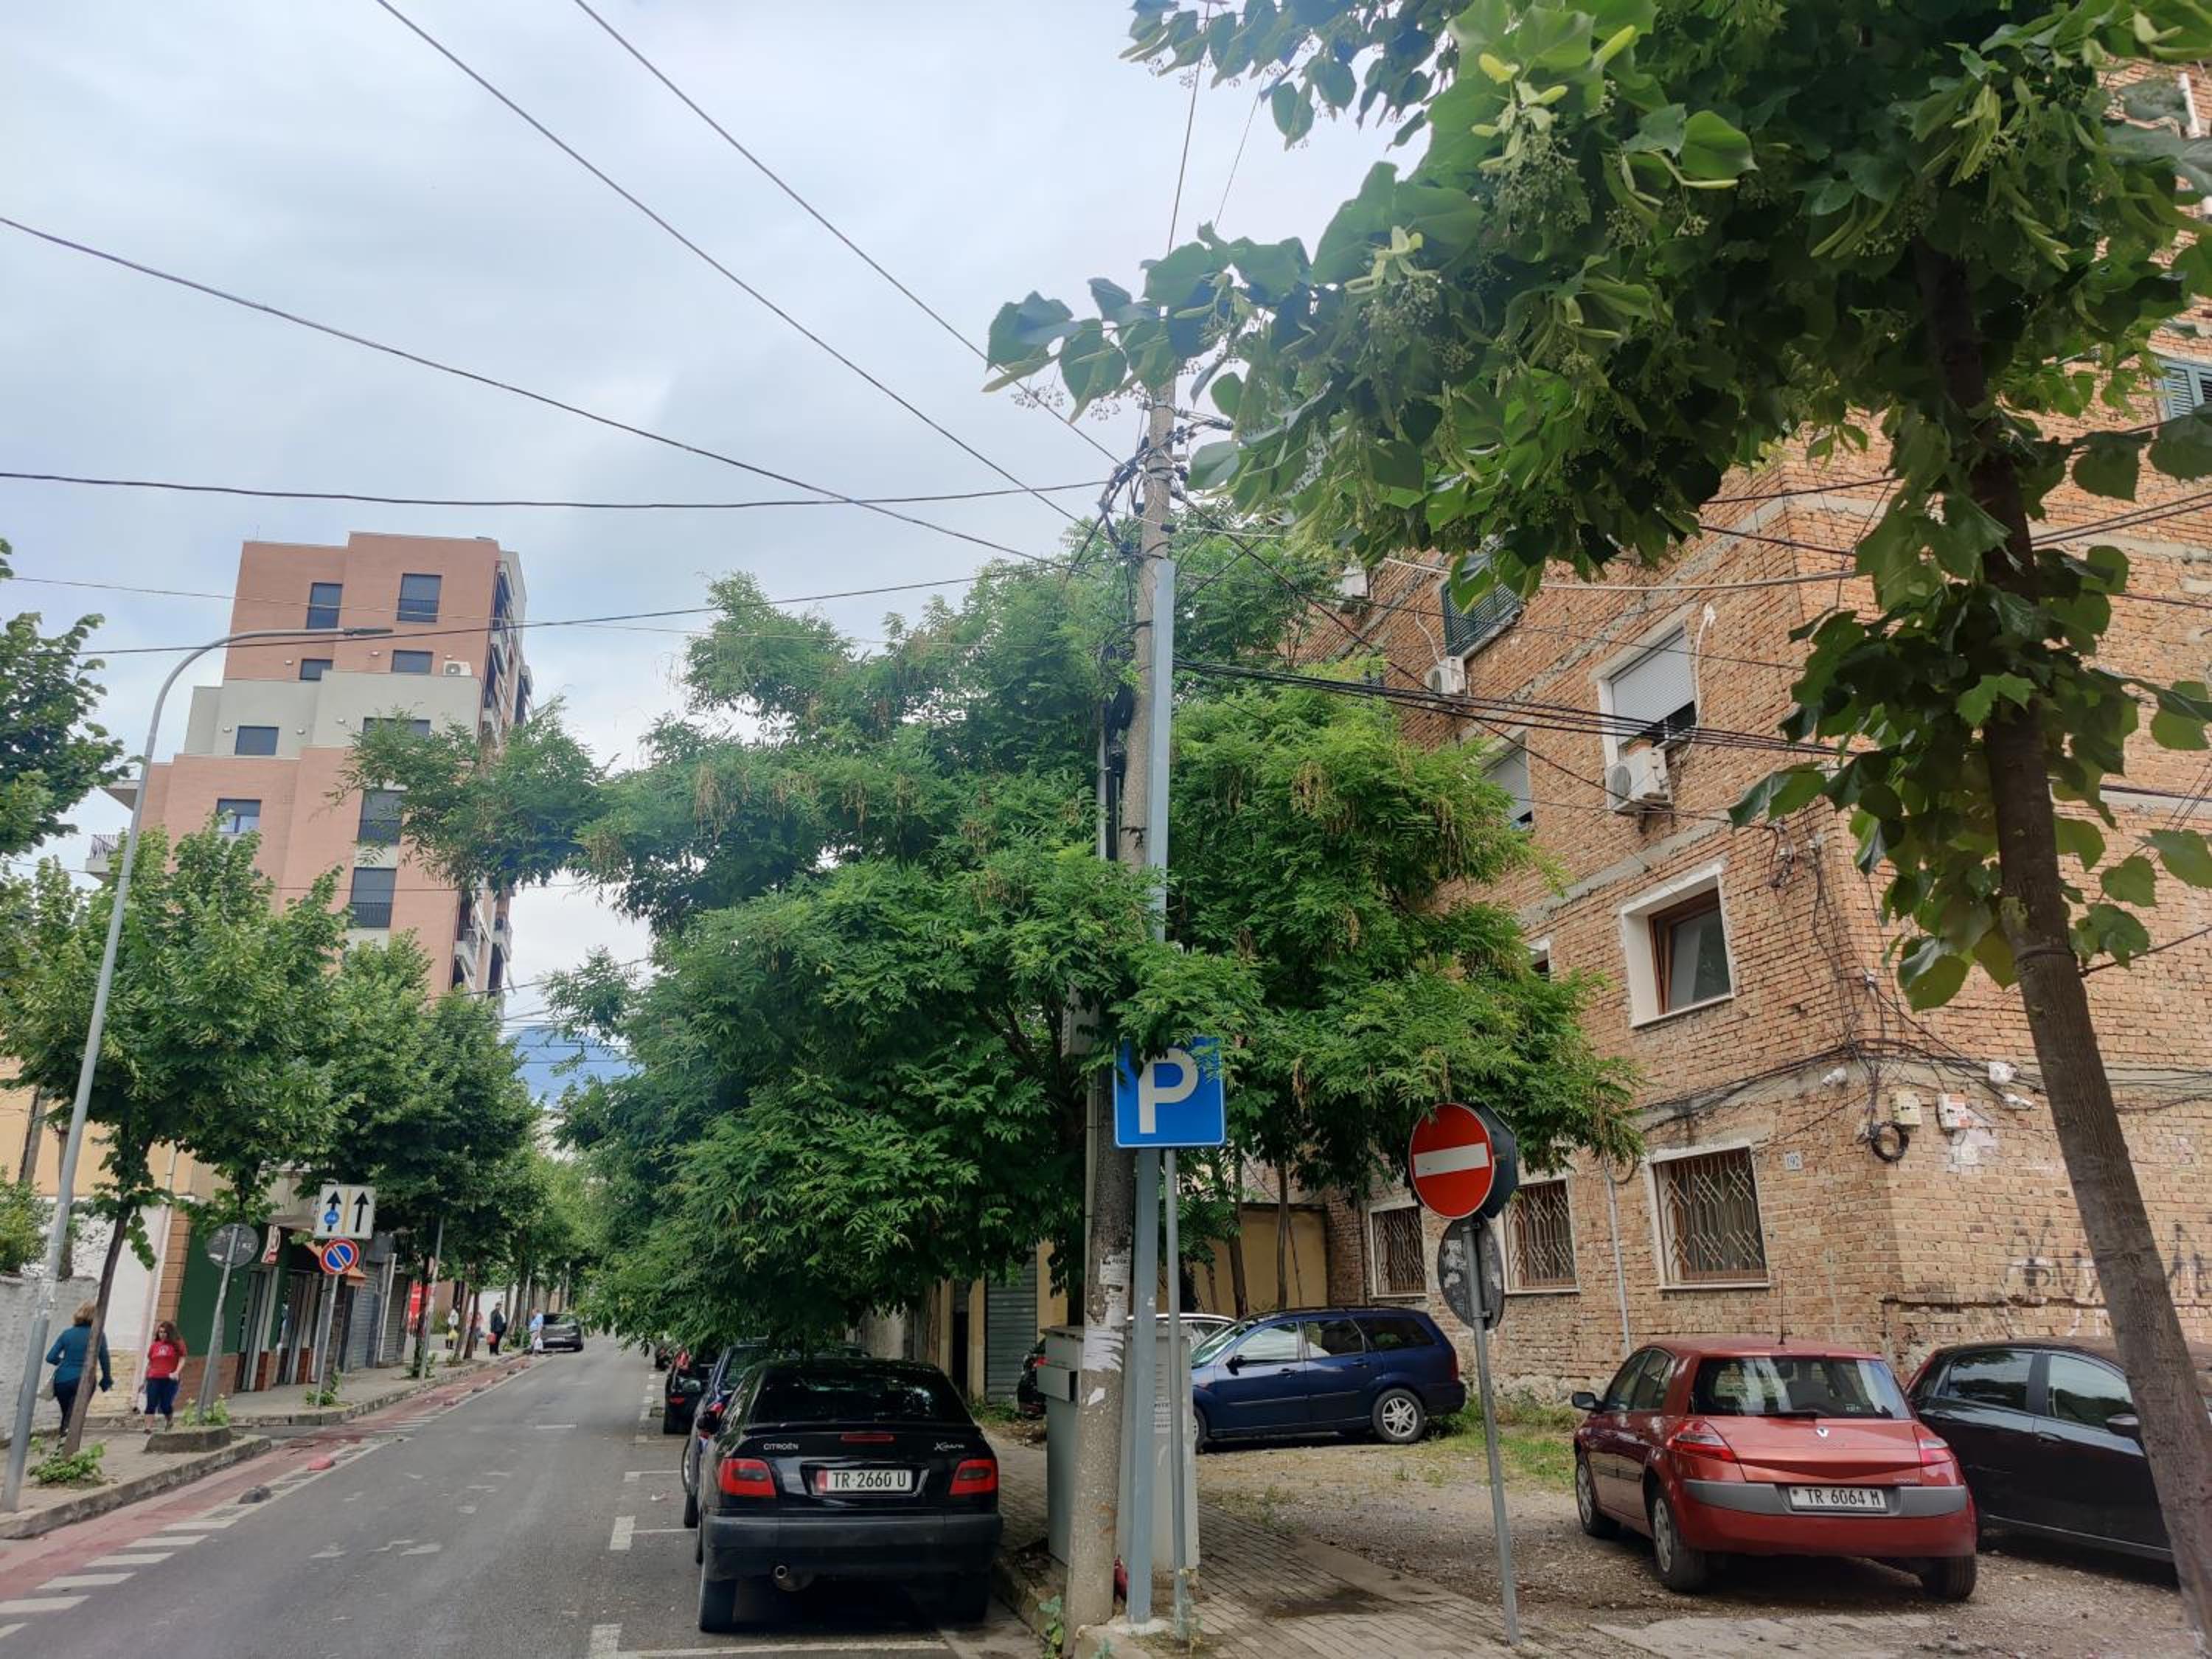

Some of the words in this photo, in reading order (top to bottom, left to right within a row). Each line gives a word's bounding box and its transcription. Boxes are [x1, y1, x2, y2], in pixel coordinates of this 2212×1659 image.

[1138, 1047, 1198, 1133] P
[832, 1472, 849, 1487] TR
[858, 1472, 891, 1487] 2660
[897, 1472, 905, 1486] U
[1805, 1489, 1823, 1503] TR
[1832, 1489, 1865, 1504] 6064
[1870, 1490, 1880, 1505] M
